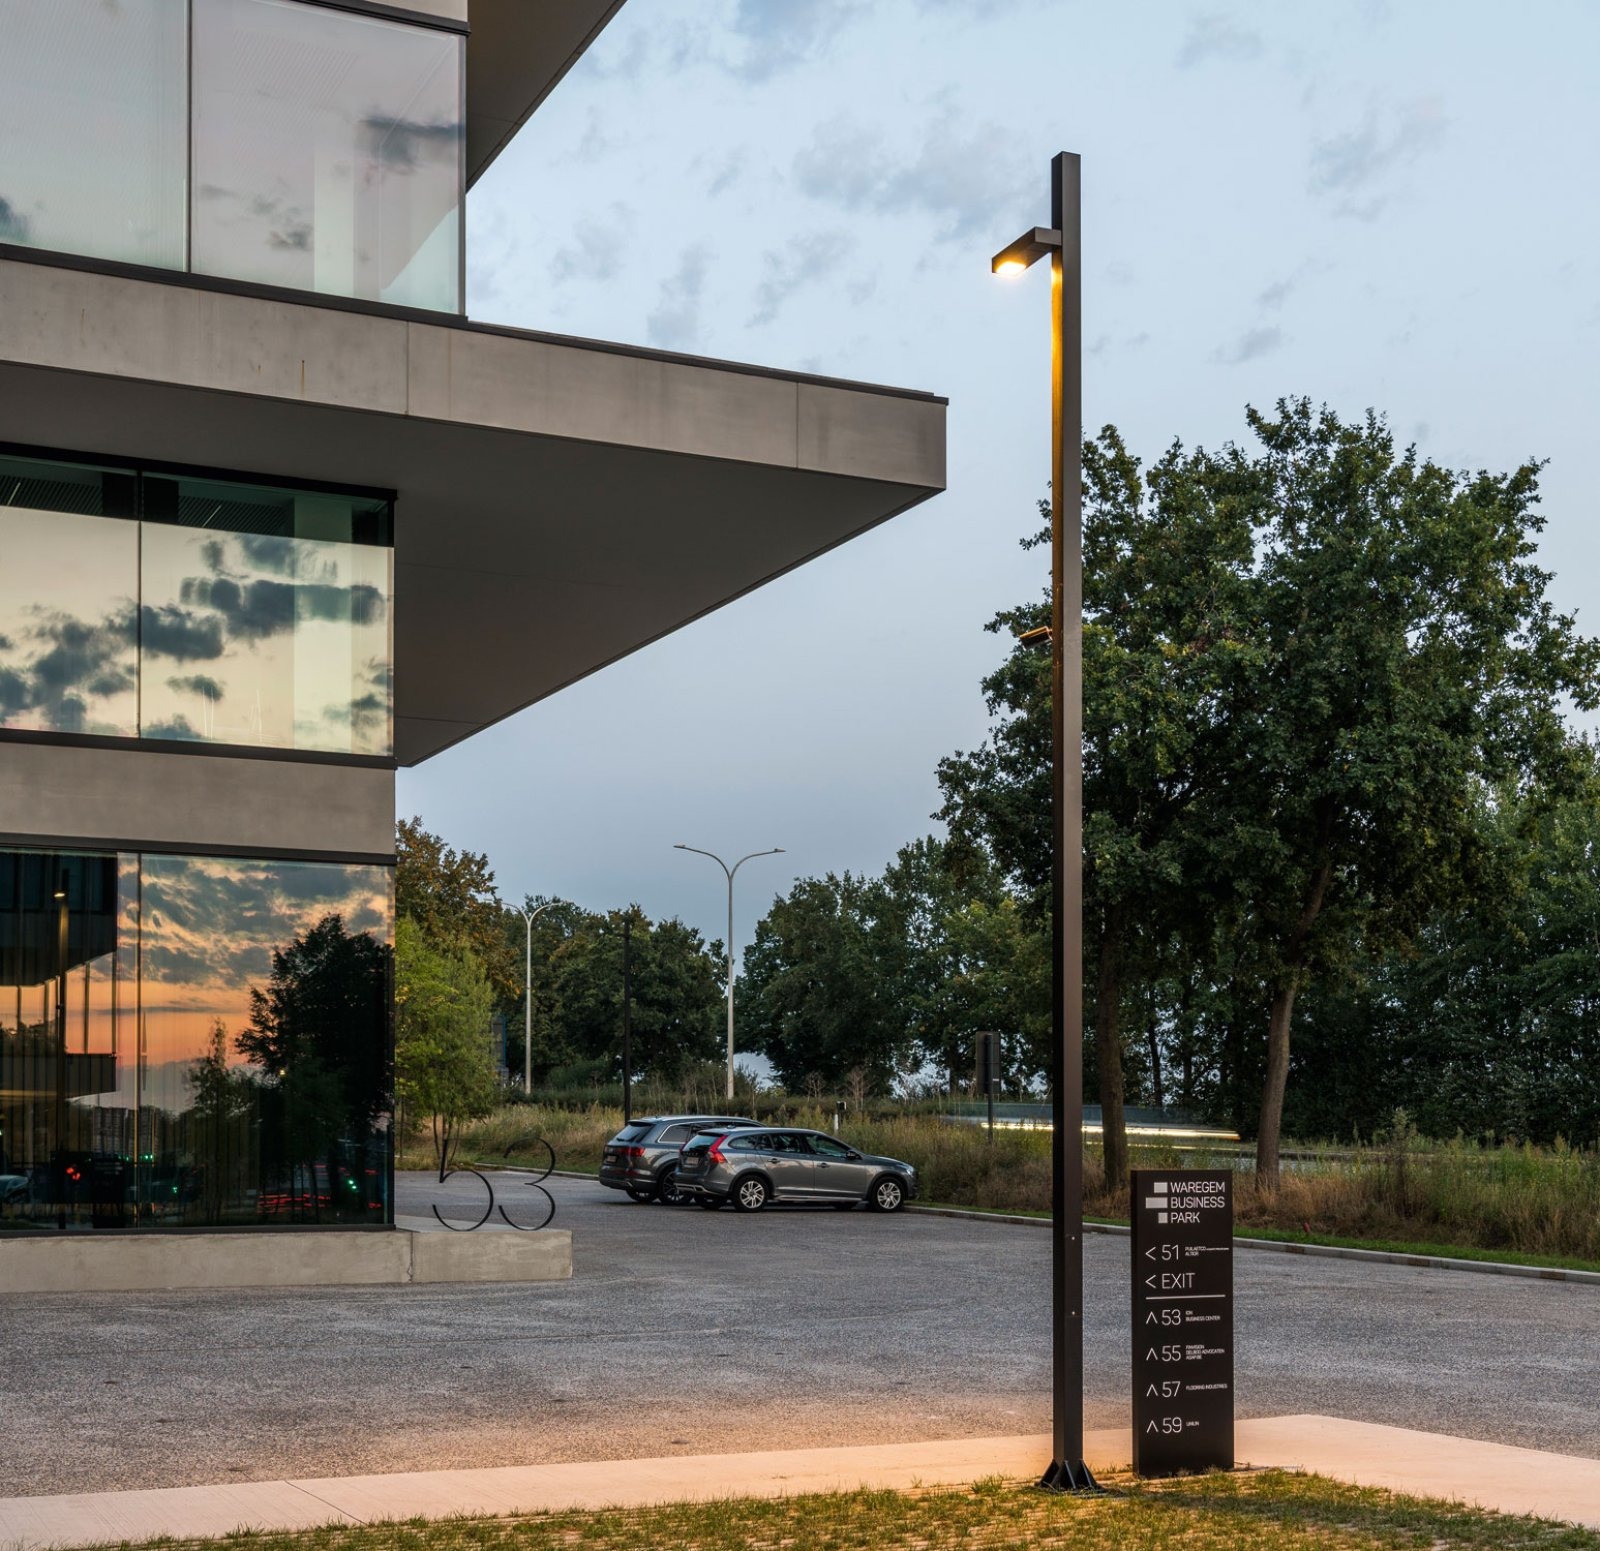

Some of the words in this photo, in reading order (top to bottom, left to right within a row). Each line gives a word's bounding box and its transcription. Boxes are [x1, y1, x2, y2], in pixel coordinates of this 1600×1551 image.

[432, 1137, 556, 1232] 53
[1170, 1181, 1225, 1193] WAREGEM
[1170, 1196, 1225, 1209] BUSINESS
[1170, 1212, 1200, 1224] PARK
[1161, 1244, 1179, 1261] 51
[1161, 1272, 1196, 1289] EXIT
[1161, 1309, 1181, 1326] 53
[1161, 1345, 1181, 1362] 55
[1161, 1381, 1181, 1398] 57
[1162, 1417, 1182, 1434] 59
